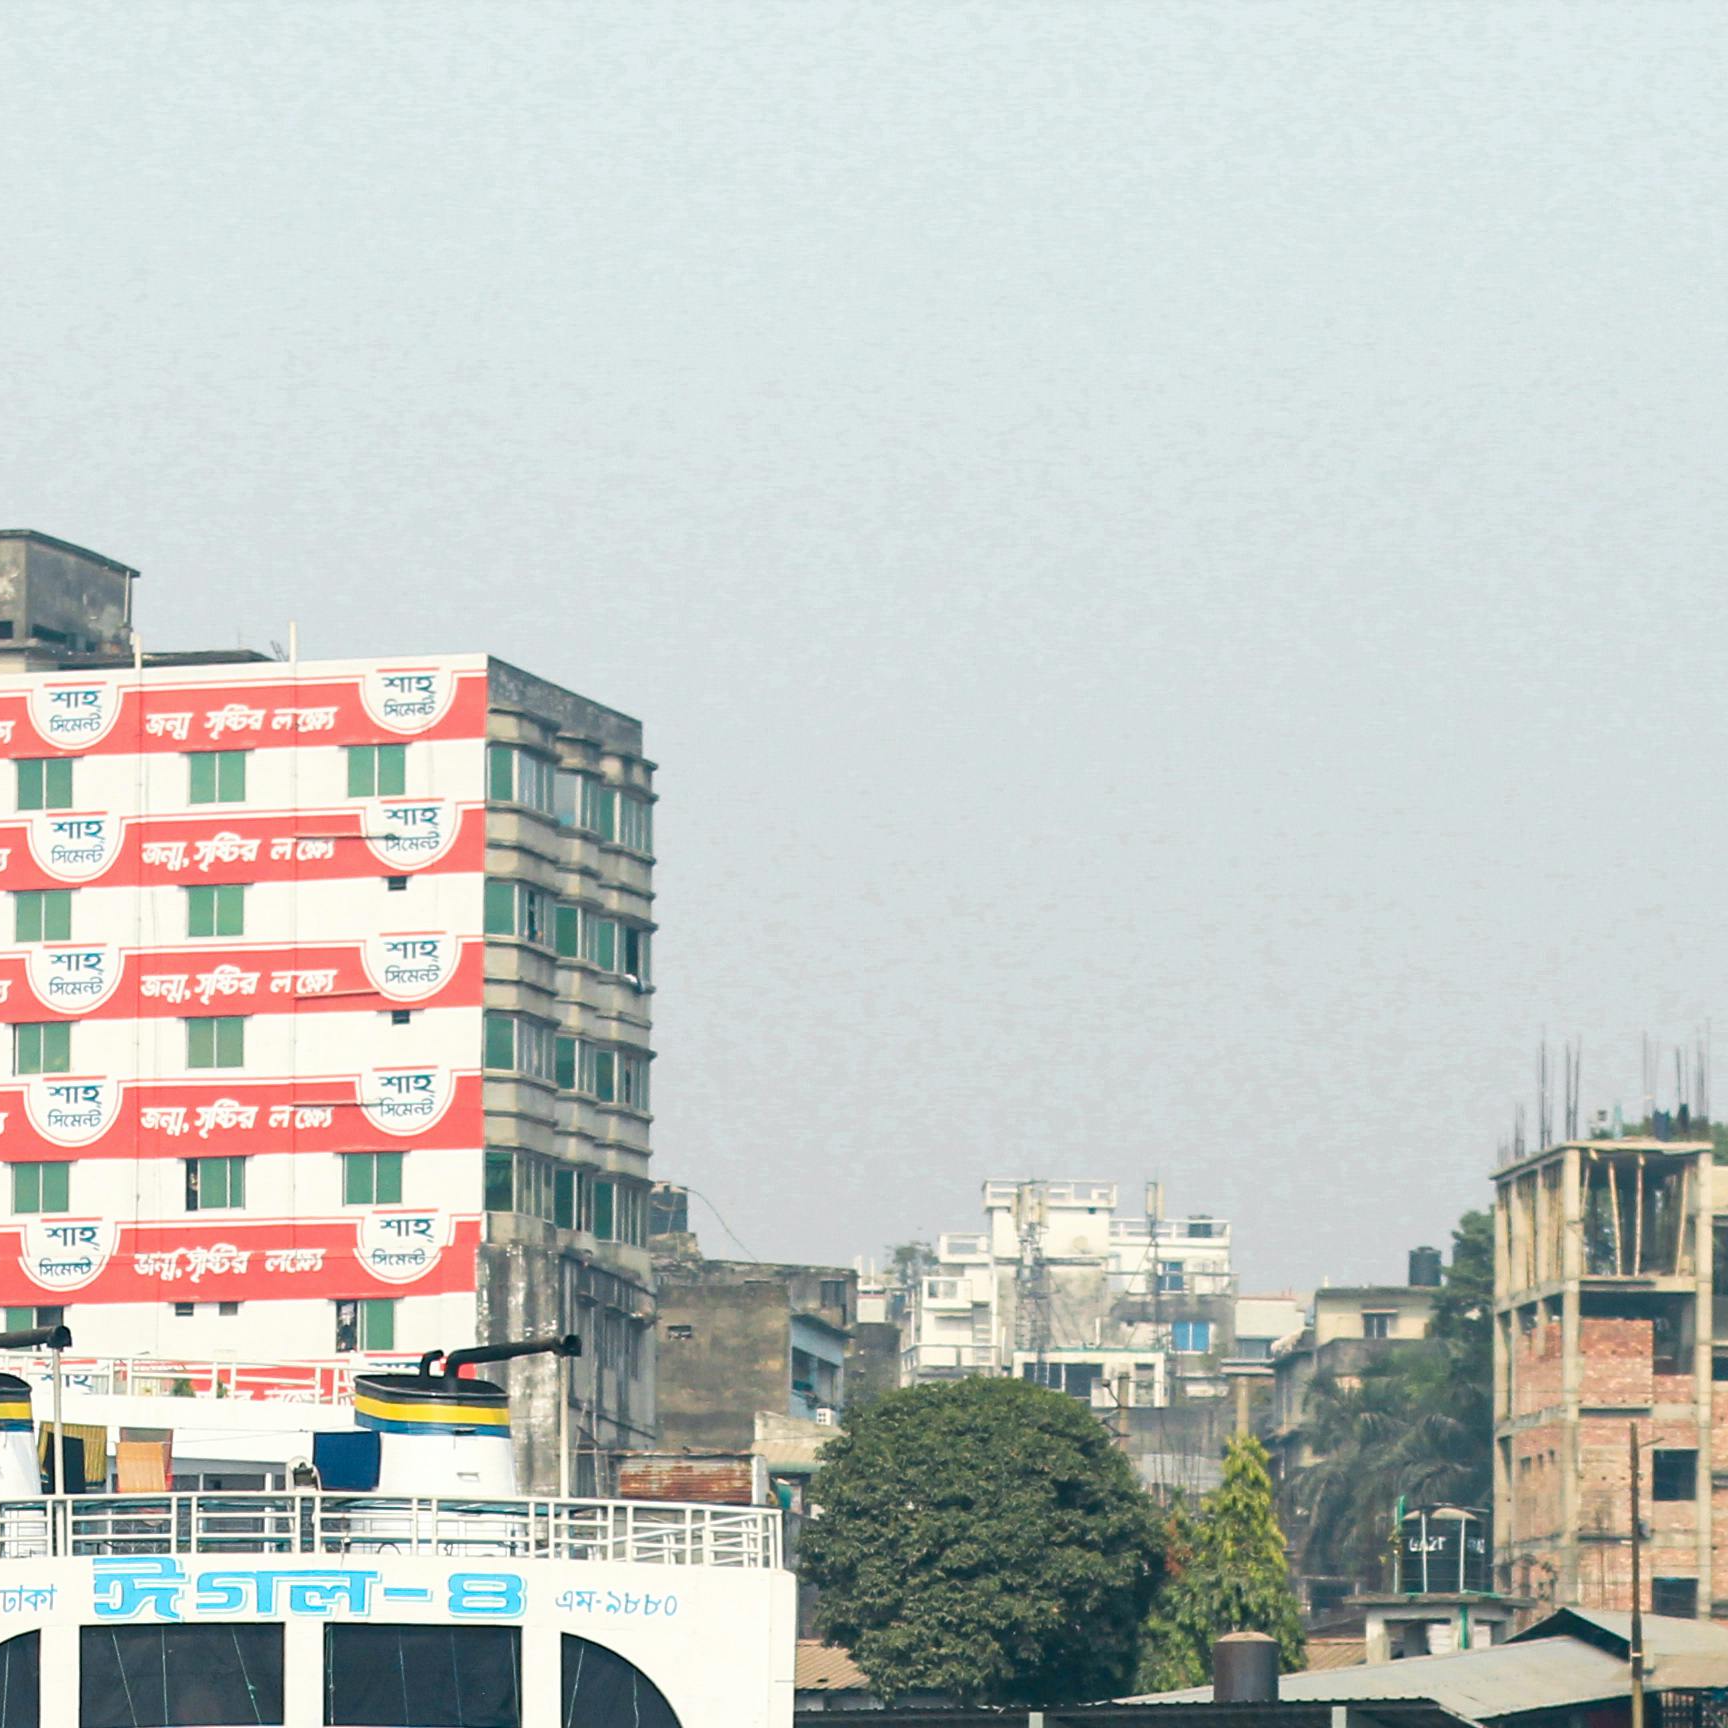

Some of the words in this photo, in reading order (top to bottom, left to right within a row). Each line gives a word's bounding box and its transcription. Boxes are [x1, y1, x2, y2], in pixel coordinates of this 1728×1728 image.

[383, 697, 435, 716] সিমেন্ট
[49, 713, 101, 732] সিমেন্ট
[204, 703, 268, 740] সৃষ্টির
[51, 844, 102, 862] সিমেন্ট
[193, 831, 262, 872] সৃষ্টির
[384, 965, 440, 983] সিমেন্ট
[49, 976, 103, 996] সিমেন্ট
[194, 964, 262, 1005] সৃষ্টির
[380, 1098, 435, 1116] সিমেন্ট
[47, 1108, 102, 1127] সিমেন্ট
[193, 1098, 260, 1139] সৃষ্টির
[185, 1243, 256, 1283] সৃষ্টির
[371, 1247, 426, 1265] সিমেন্ট
[39, 1257, 93, 1275] সিমেন্ট
[555, 1590, 678, 1616] এম-৯৮৮০
